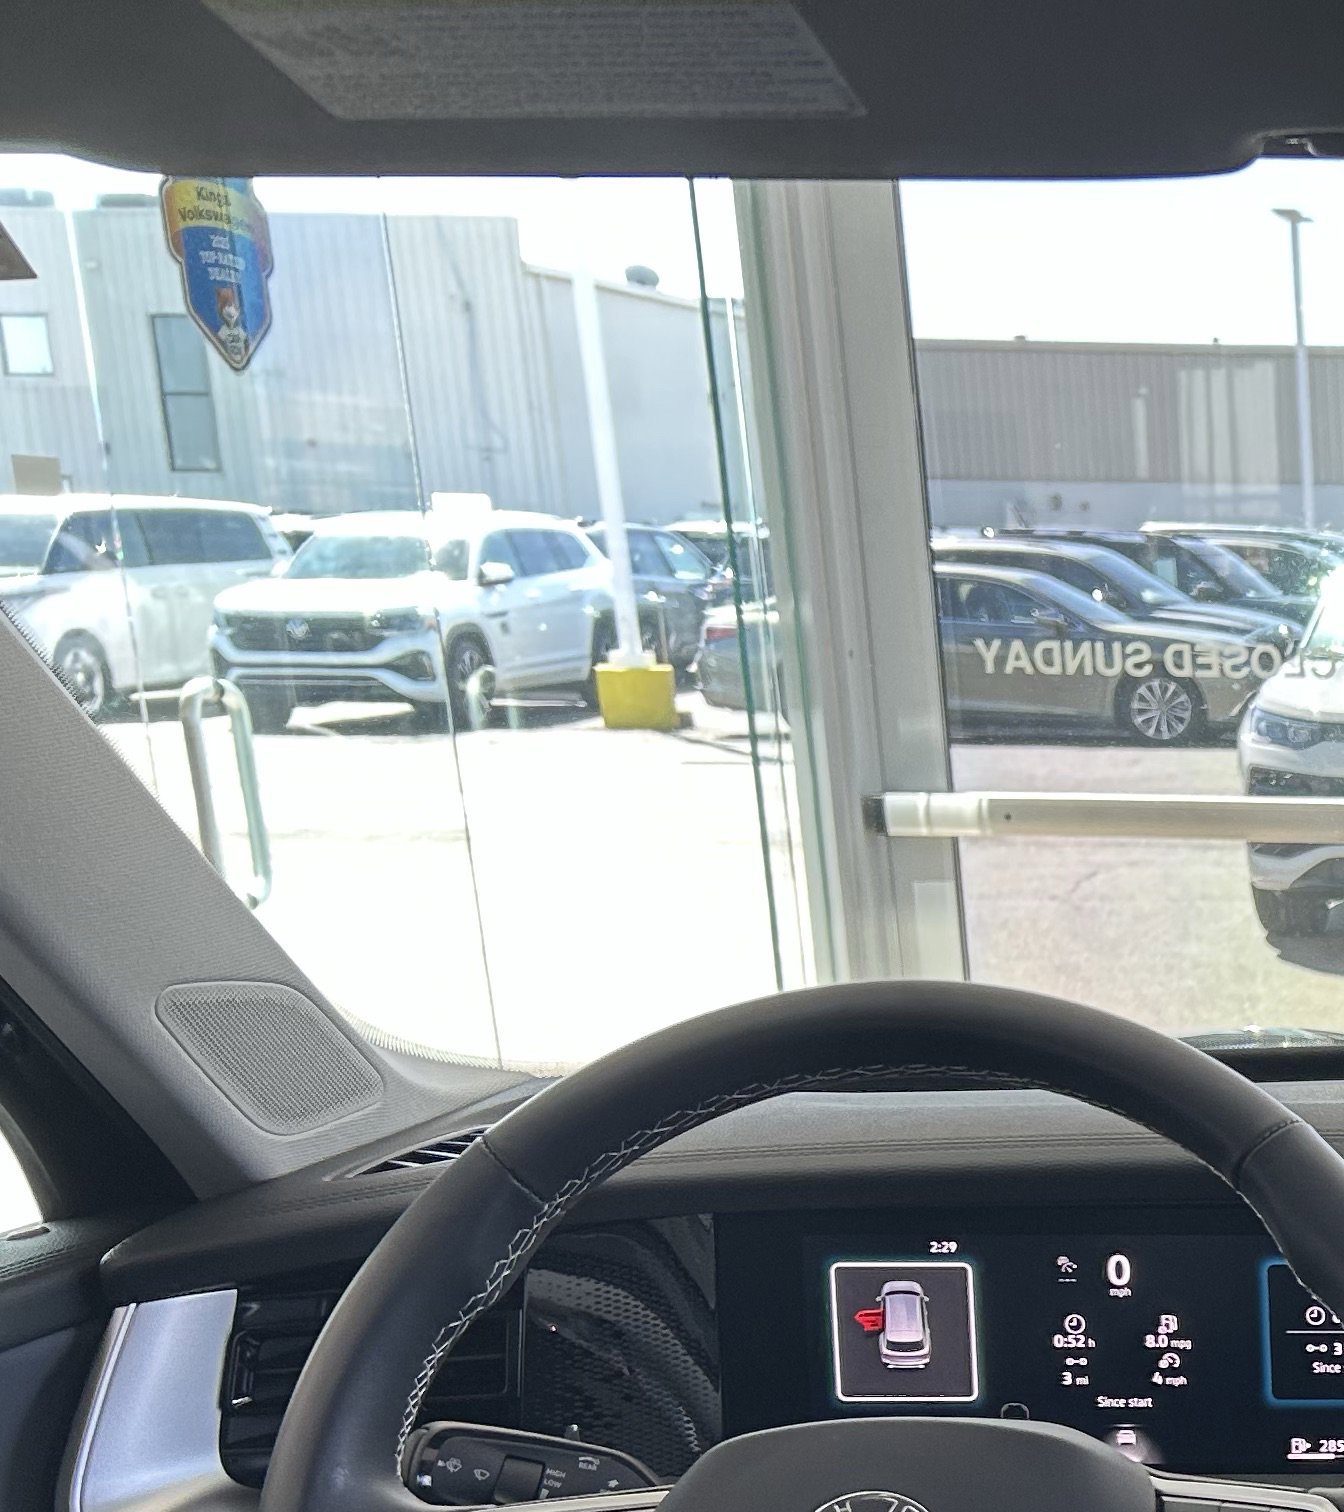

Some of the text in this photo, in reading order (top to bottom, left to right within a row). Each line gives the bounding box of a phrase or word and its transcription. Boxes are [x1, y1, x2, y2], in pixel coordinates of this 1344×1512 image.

[929, 1240, 958, 1253] 2:29
[1106, 1253, 1132, 1287] 0
[1109, 1287, 1132, 1297] mph
[1053, 1334, 1086, 1348] 0:52
[1144, 1334, 1192, 1350] 8.0 mpg
[1333, 1343, 1343, 1356] 3
[1312, 1362, 1341, 1374] Since
[1061, 1371, 1090, 1386] 3 mi
[1151, 1371, 1188, 1388] 4 mph
[1097, 1395, 1154, 1408] Since start
[1319, 1440, 1344, 1453] 285
